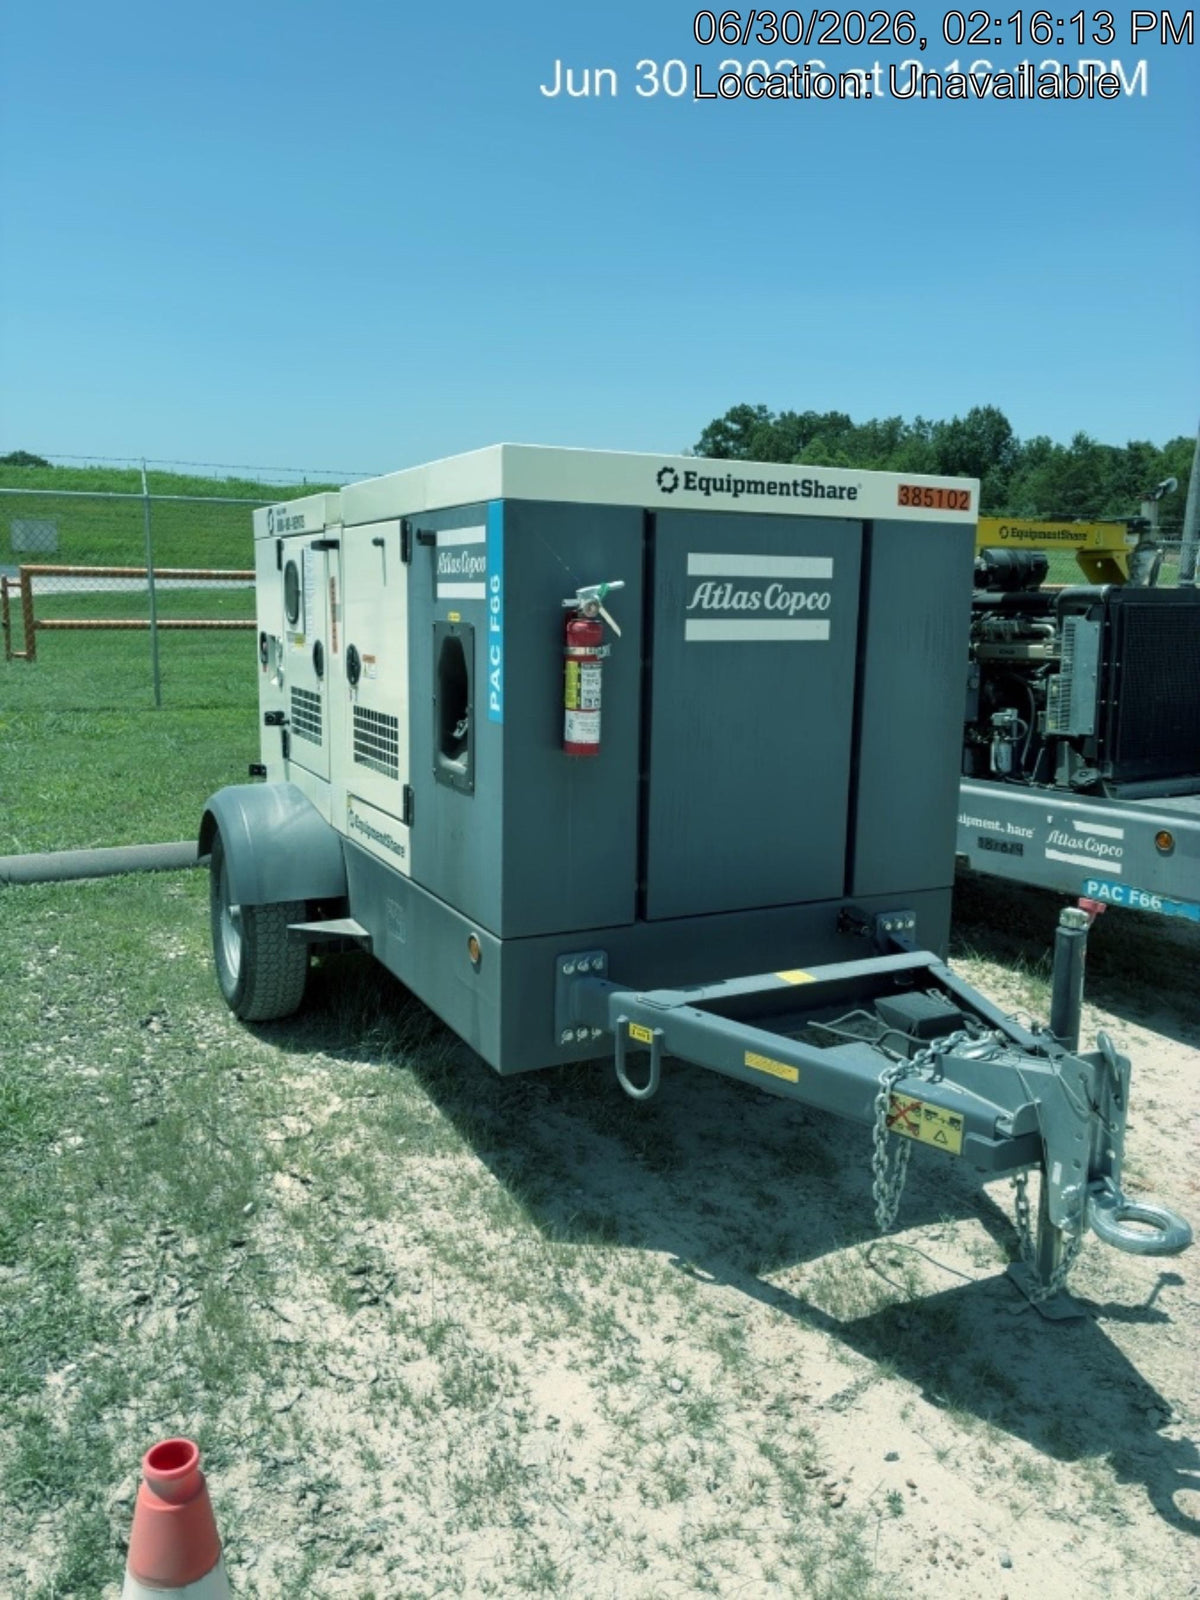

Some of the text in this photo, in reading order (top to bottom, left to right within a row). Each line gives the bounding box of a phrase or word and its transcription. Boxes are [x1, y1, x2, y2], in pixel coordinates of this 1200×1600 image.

[683, 470, 859, 500] EquipmentShare
[900, 486, 969, 511] 385102
[686, 581, 832, 616] Atlas Copco
[489, 574, 501, 712] PAC F66
[1046, 830, 1083, 849] Atlas
[1084, 836, 1124, 858] Copco
[1087, 880, 1162, 910] PAC F66
